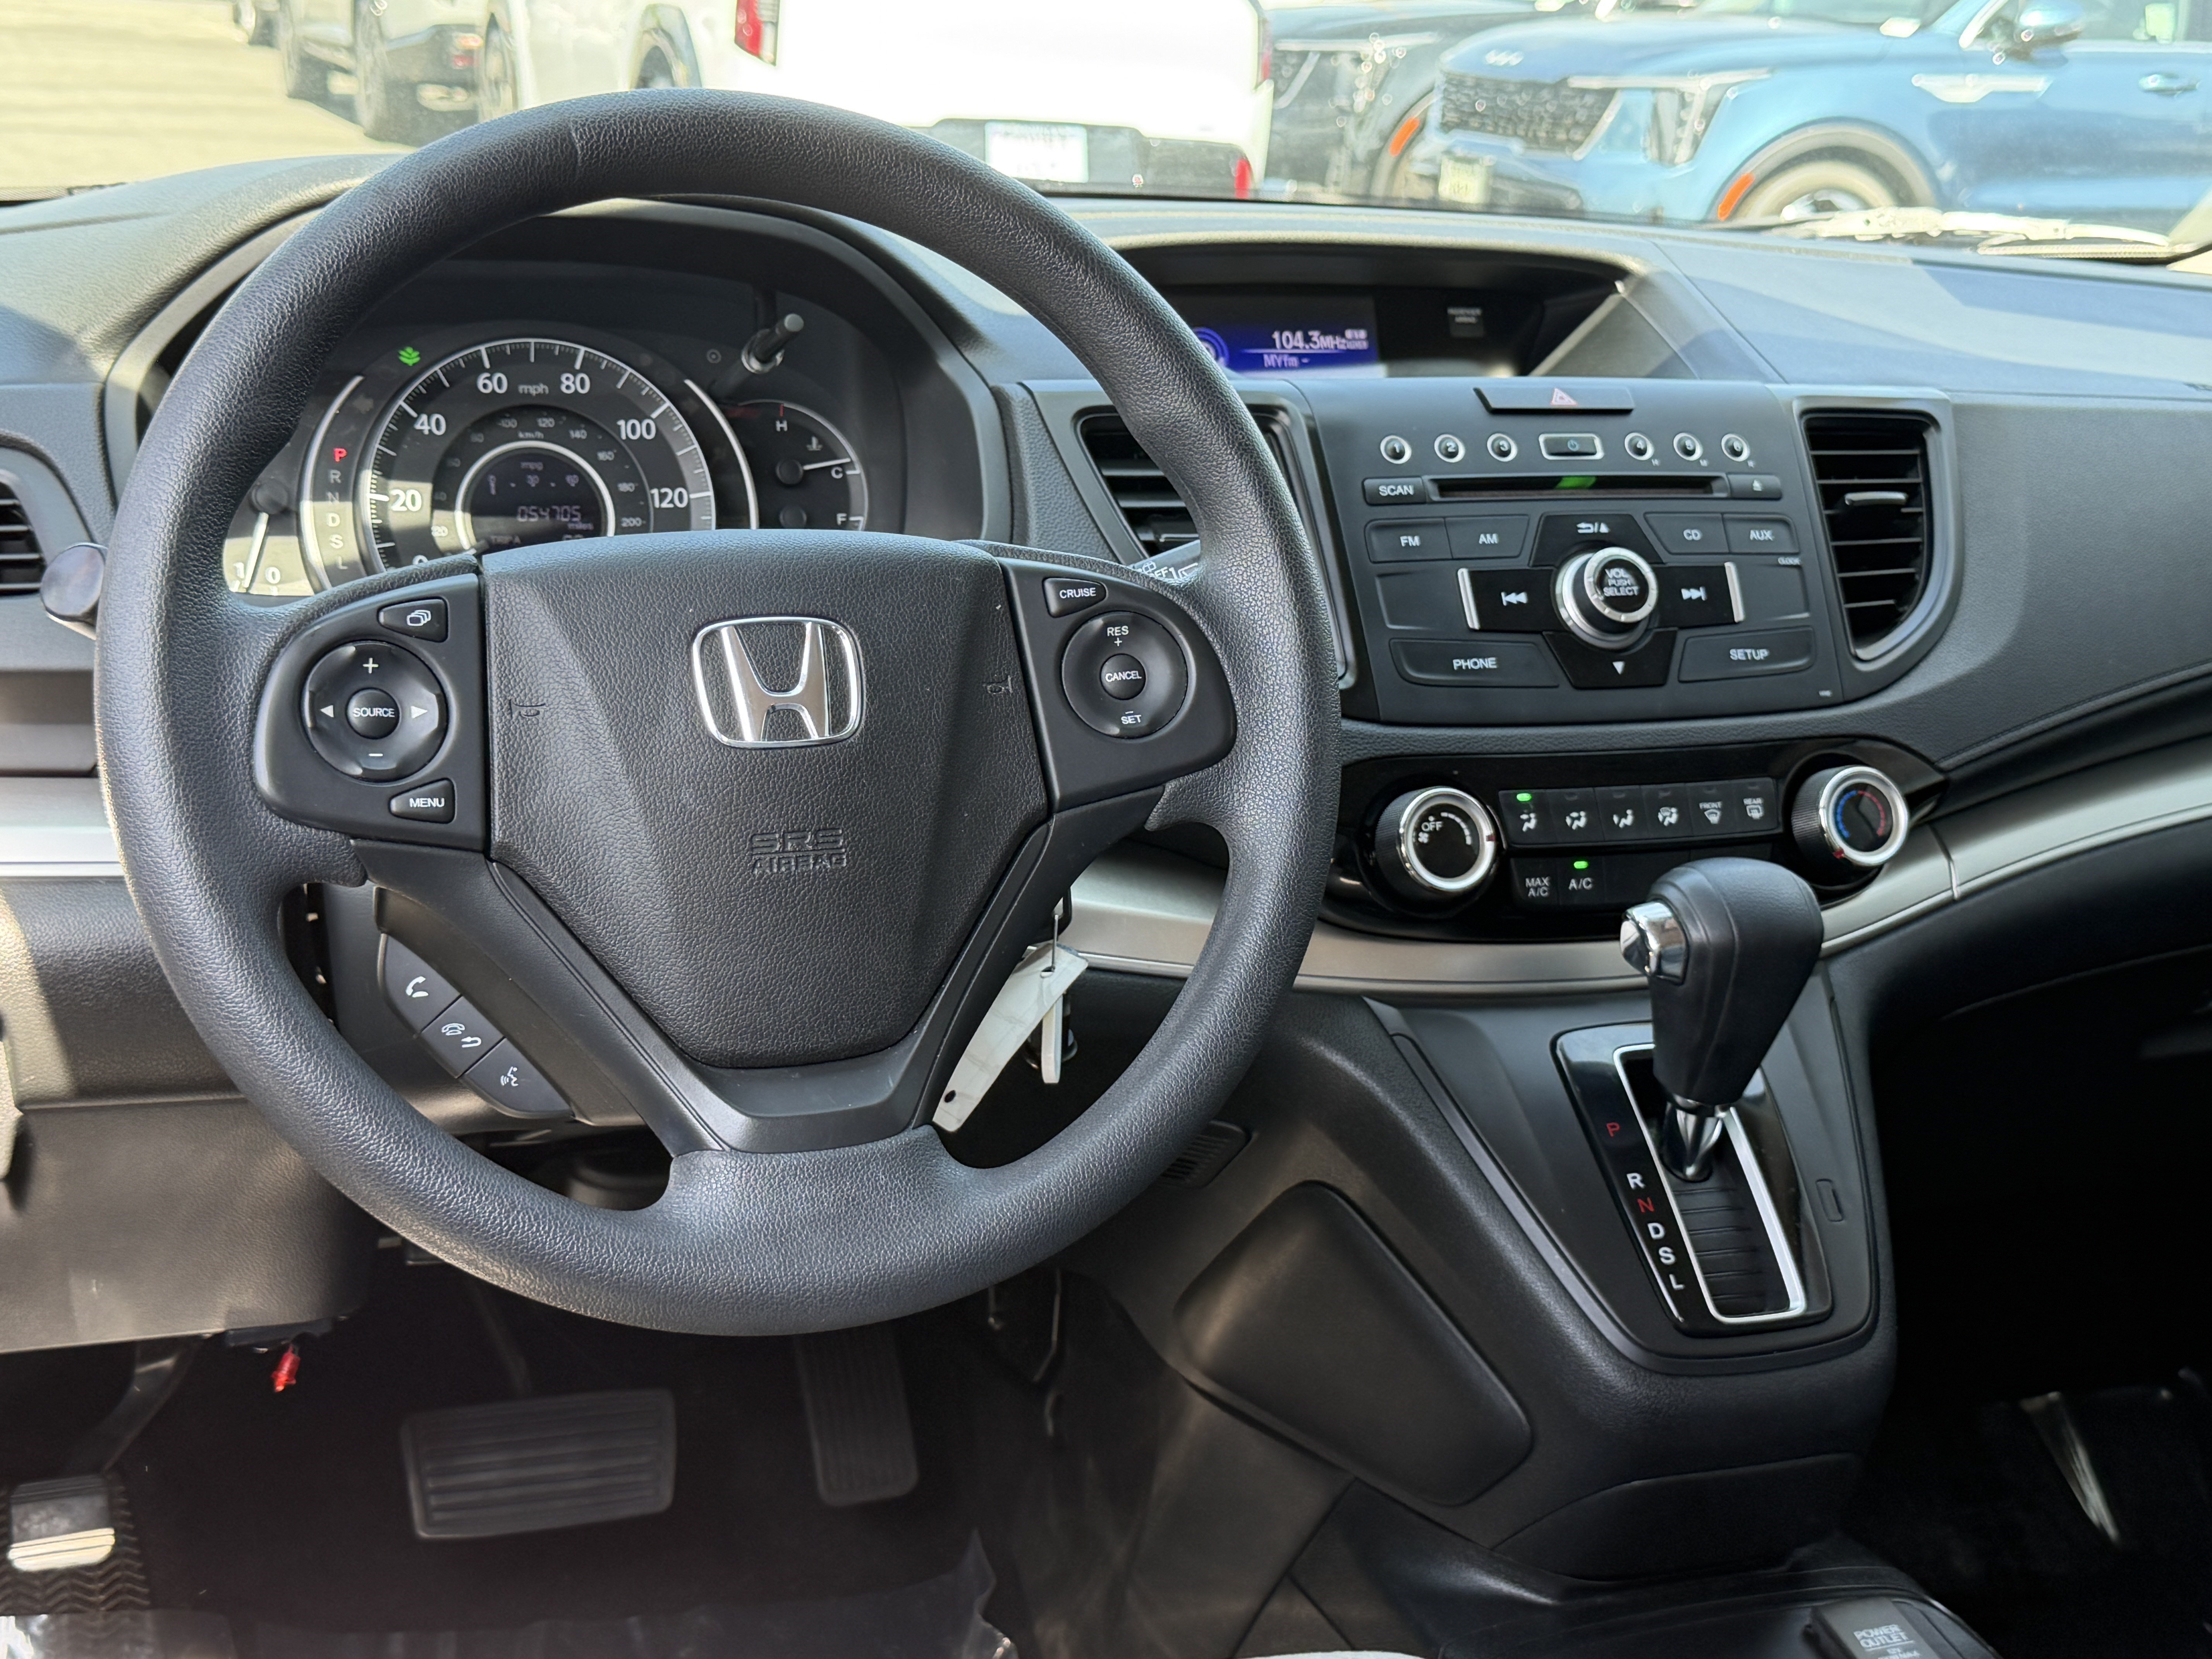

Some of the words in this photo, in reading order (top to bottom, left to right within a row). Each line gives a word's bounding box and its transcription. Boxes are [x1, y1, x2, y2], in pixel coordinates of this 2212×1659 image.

[477, 373, 508, 393] 60
[560, 373, 590, 394] 80
[518, 383, 549, 397] mph
[415, 414, 447, 435] 40
[537, 418, 555, 428] 120
[776, 420, 788, 432] H
[569, 430, 587, 439] 140
[617, 419, 656, 440] 100
[1394, 443, 1400, 453] 1
[1447, 442, 1456, 452] 2
[1499, 442, 1508, 451] 3
[334, 448, 347, 462] P
[330, 469, 341, 483] R
[831, 467, 843, 479] C
[1379, 484, 1414, 496] SCAN
[327, 492, 339, 503] N
[391, 489, 422, 511] 20
[651, 488, 689, 508] 120
[517, 505, 580, 522] 054705
[328, 513, 340, 527] D
[622, 518, 642, 527] 200
[837, 514, 847, 525] F
[1479, 533, 1499, 544] AM
[1683, 529, 1702, 540] CD
[1750, 530, 1775, 541] AUX
[330, 534, 343, 549] S
[1400, 536, 1421, 547] FM
[337, 556, 348, 569] L
[233, 562, 244, 579] 1
[265, 567, 280, 584] 0
[1605, 568, 1628, 578] VOL
[1059, 587, 1096, 599] CRUISE
[1603, 586, 1639, 596] SELECT
[1107, 626, 1129, 636] RES
[1729, 649, 1769, 660] SETUP
[1453, 657, 1498, 670] PHONE
[1105, 671, 1142, 682] CANCEL
[352, 708, 395, 718] SOURCE
[1121, 714, 1141, 724] SET
[409, 798, 445, 808] MENU
[1422, 821, 1443, 831] OFF
[750, 828, 844, 852] SRS
[1525, 878, 1550, 888] MAX
[1569, 879, 1592, 890] A/C
[1528, 888, 1548, 897] A/C
[1606, 1123, 1620, 1137] P
[1626, 1173, 1644, 1190] R
[1637, 1197, 1654, 1213] N
[1647, 1223, 1665, 1238] D
[1658, 1247, 1675, 1264] S
[1669, 1274, 1685, 1290] L
[1853, 1625, 1902, 1640] POWER
[1860, 1632, 1908, 1648] OUTLET
